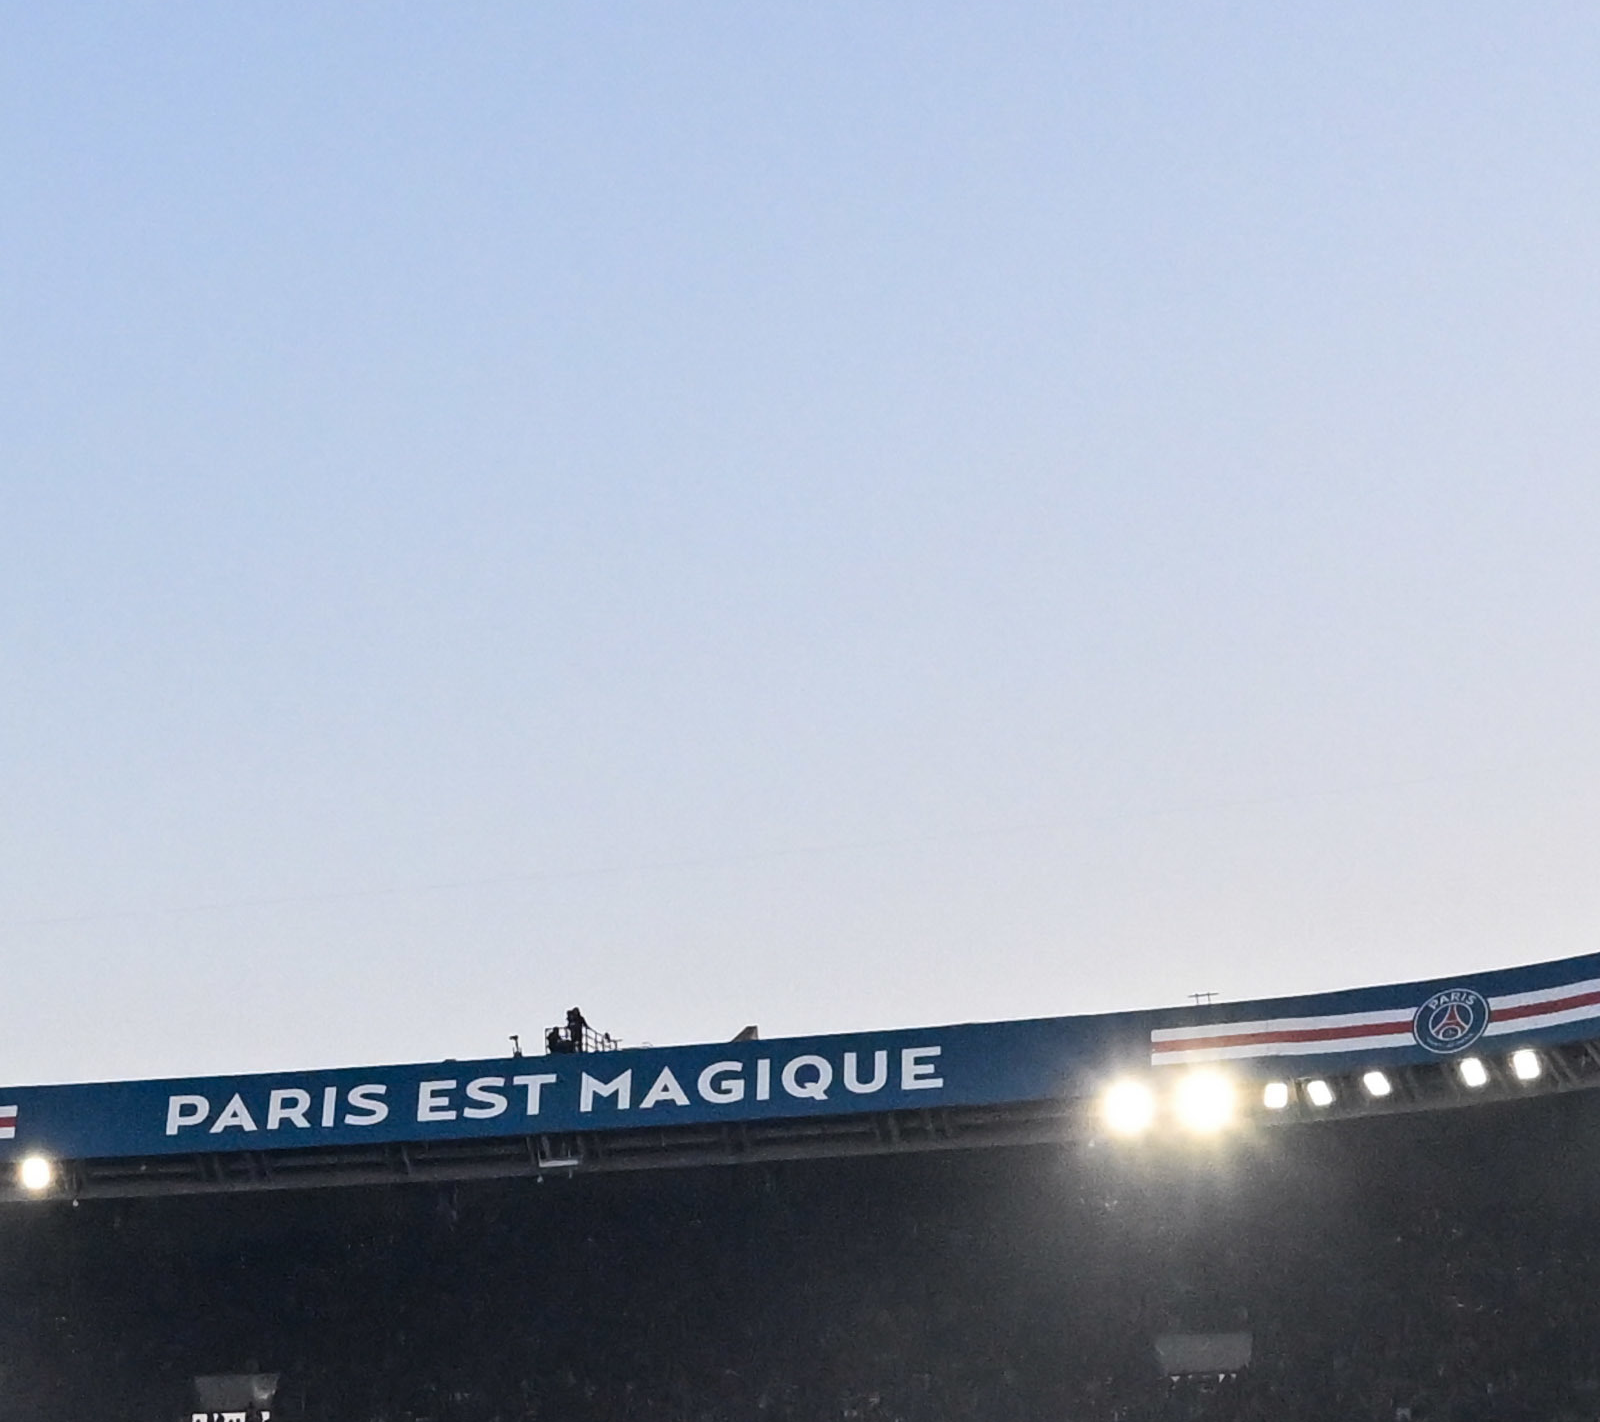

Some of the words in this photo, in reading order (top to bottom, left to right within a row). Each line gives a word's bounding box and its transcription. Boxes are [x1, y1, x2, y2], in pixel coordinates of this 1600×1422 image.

[1428, 992, 1477, 1010] PARIS
[166, 1083, 389, 1136] PARIS
[416, 1073, 557, 1122] EST
[579, 1045, 945, 1113] MAGIQUE
